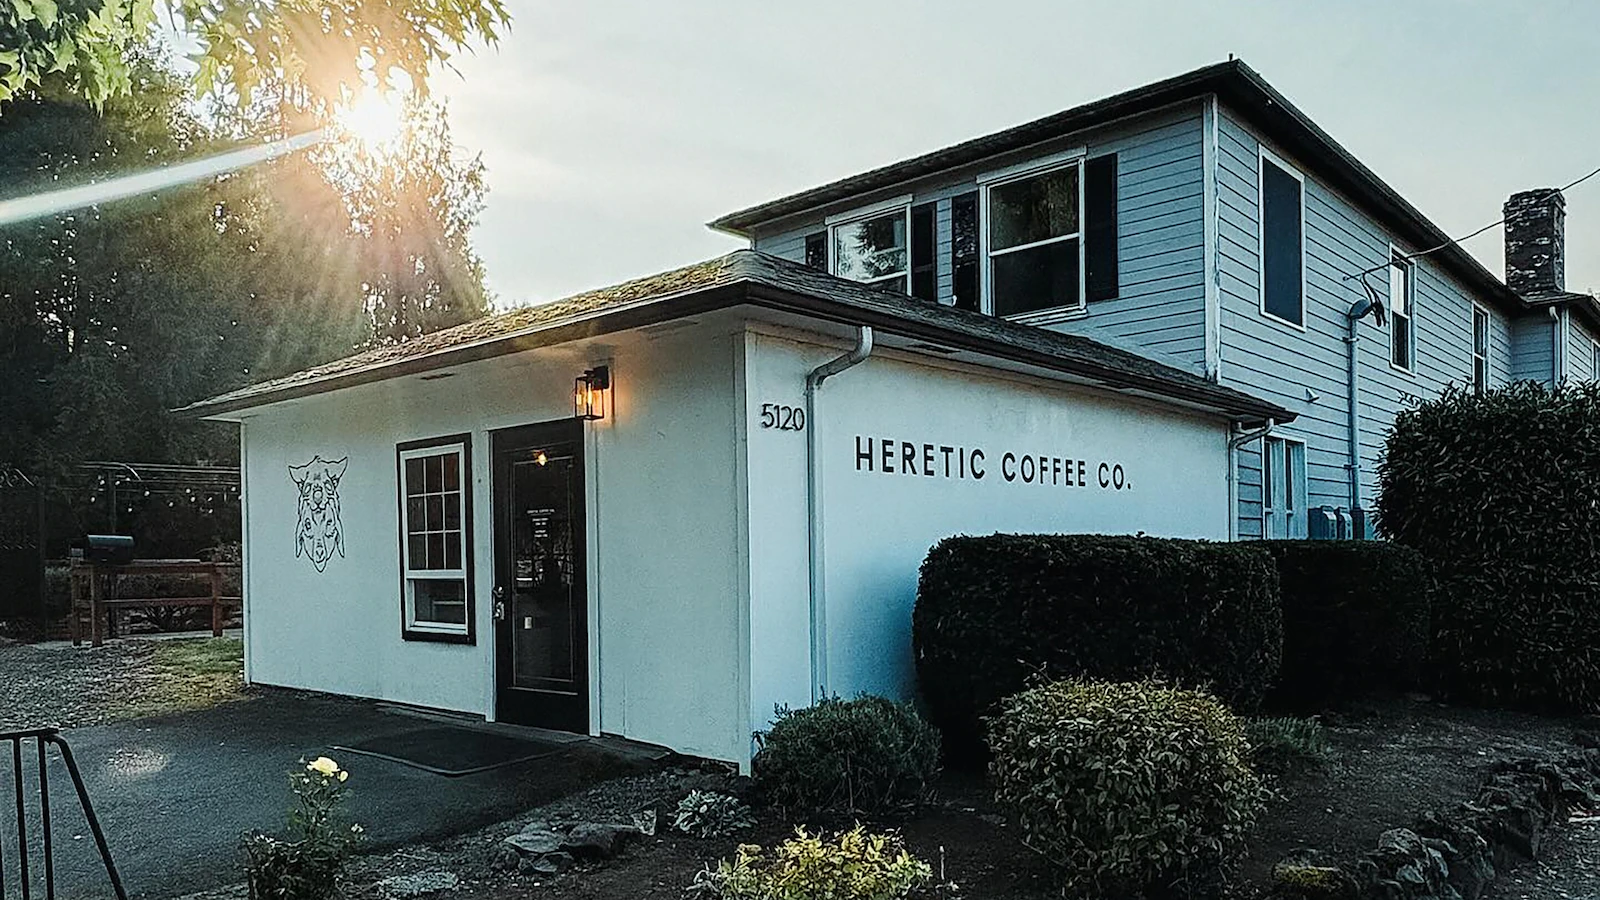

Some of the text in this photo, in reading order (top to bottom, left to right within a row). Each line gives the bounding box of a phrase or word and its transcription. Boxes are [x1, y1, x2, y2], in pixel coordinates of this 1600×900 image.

[760, 403, 806, 432] 5120
[854, 435, 1132, 491] HERETIC COFFEE CO.
